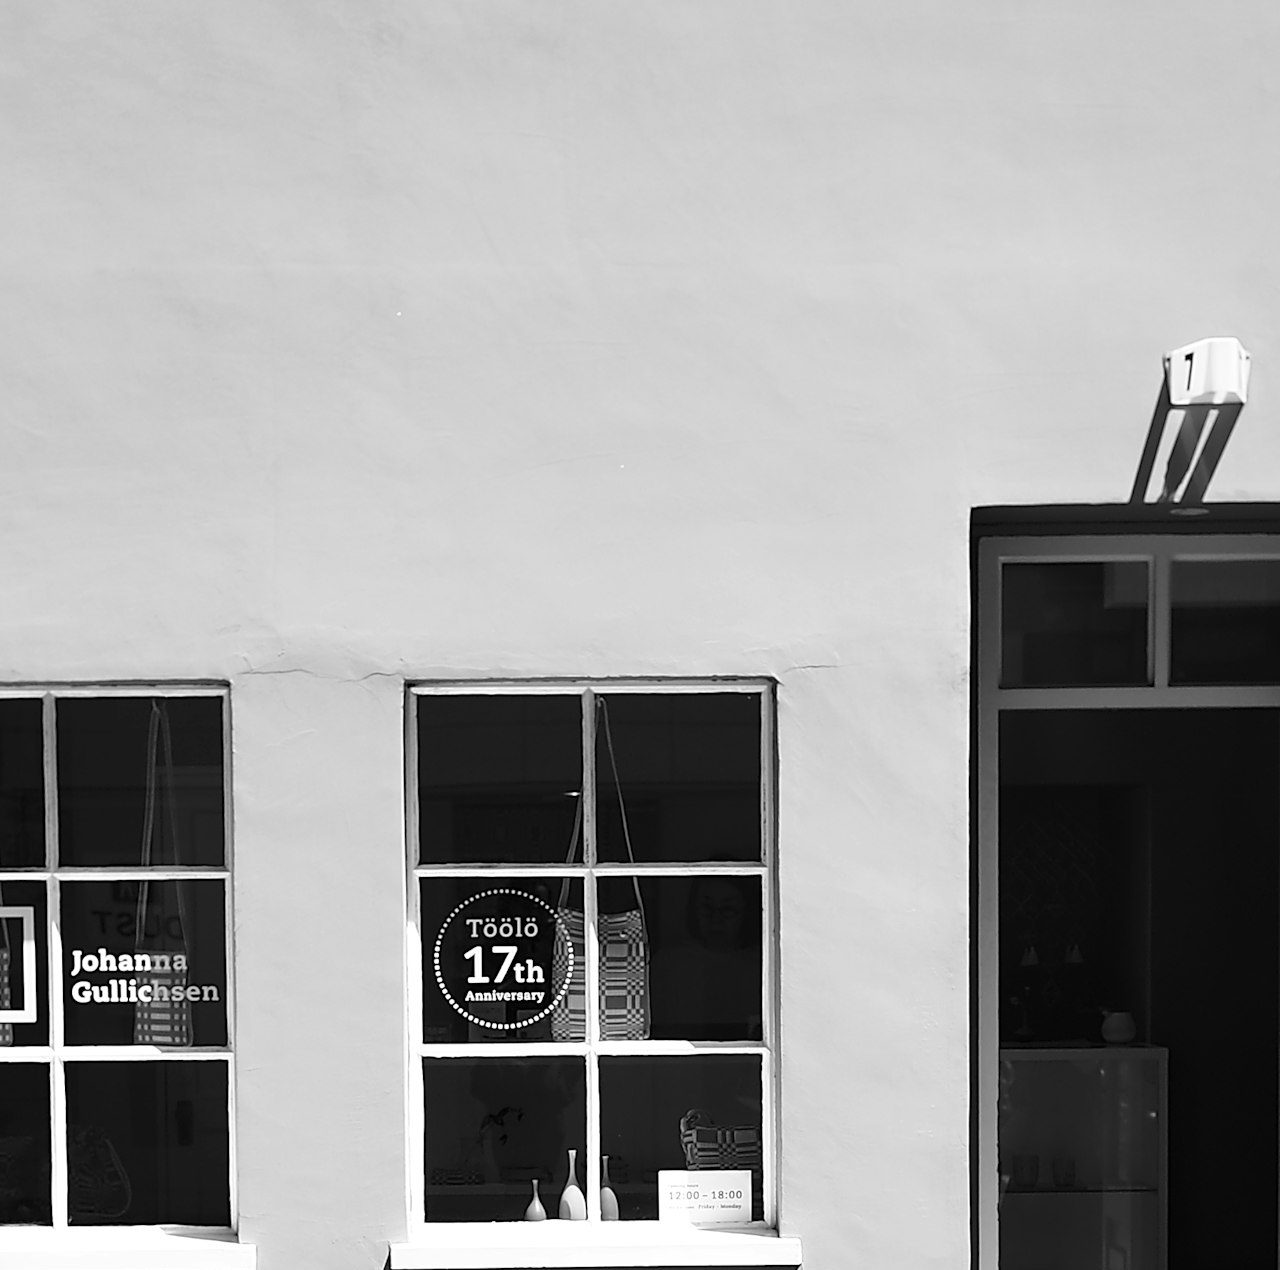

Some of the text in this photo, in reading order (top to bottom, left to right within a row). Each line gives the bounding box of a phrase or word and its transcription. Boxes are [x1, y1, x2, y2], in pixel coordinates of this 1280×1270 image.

[465, 917, 538, 938] Töölö
[71, 948, 188, 976] Johanna
[463, 946, 545, 984] 17th
[71, 979, 219, 1003] Gullichsen
[465, 989, 545, 1004] Anniversary
[669, 1191, 700, 1200] 12:00
[711, 1190, 742, 1200] 18:00
